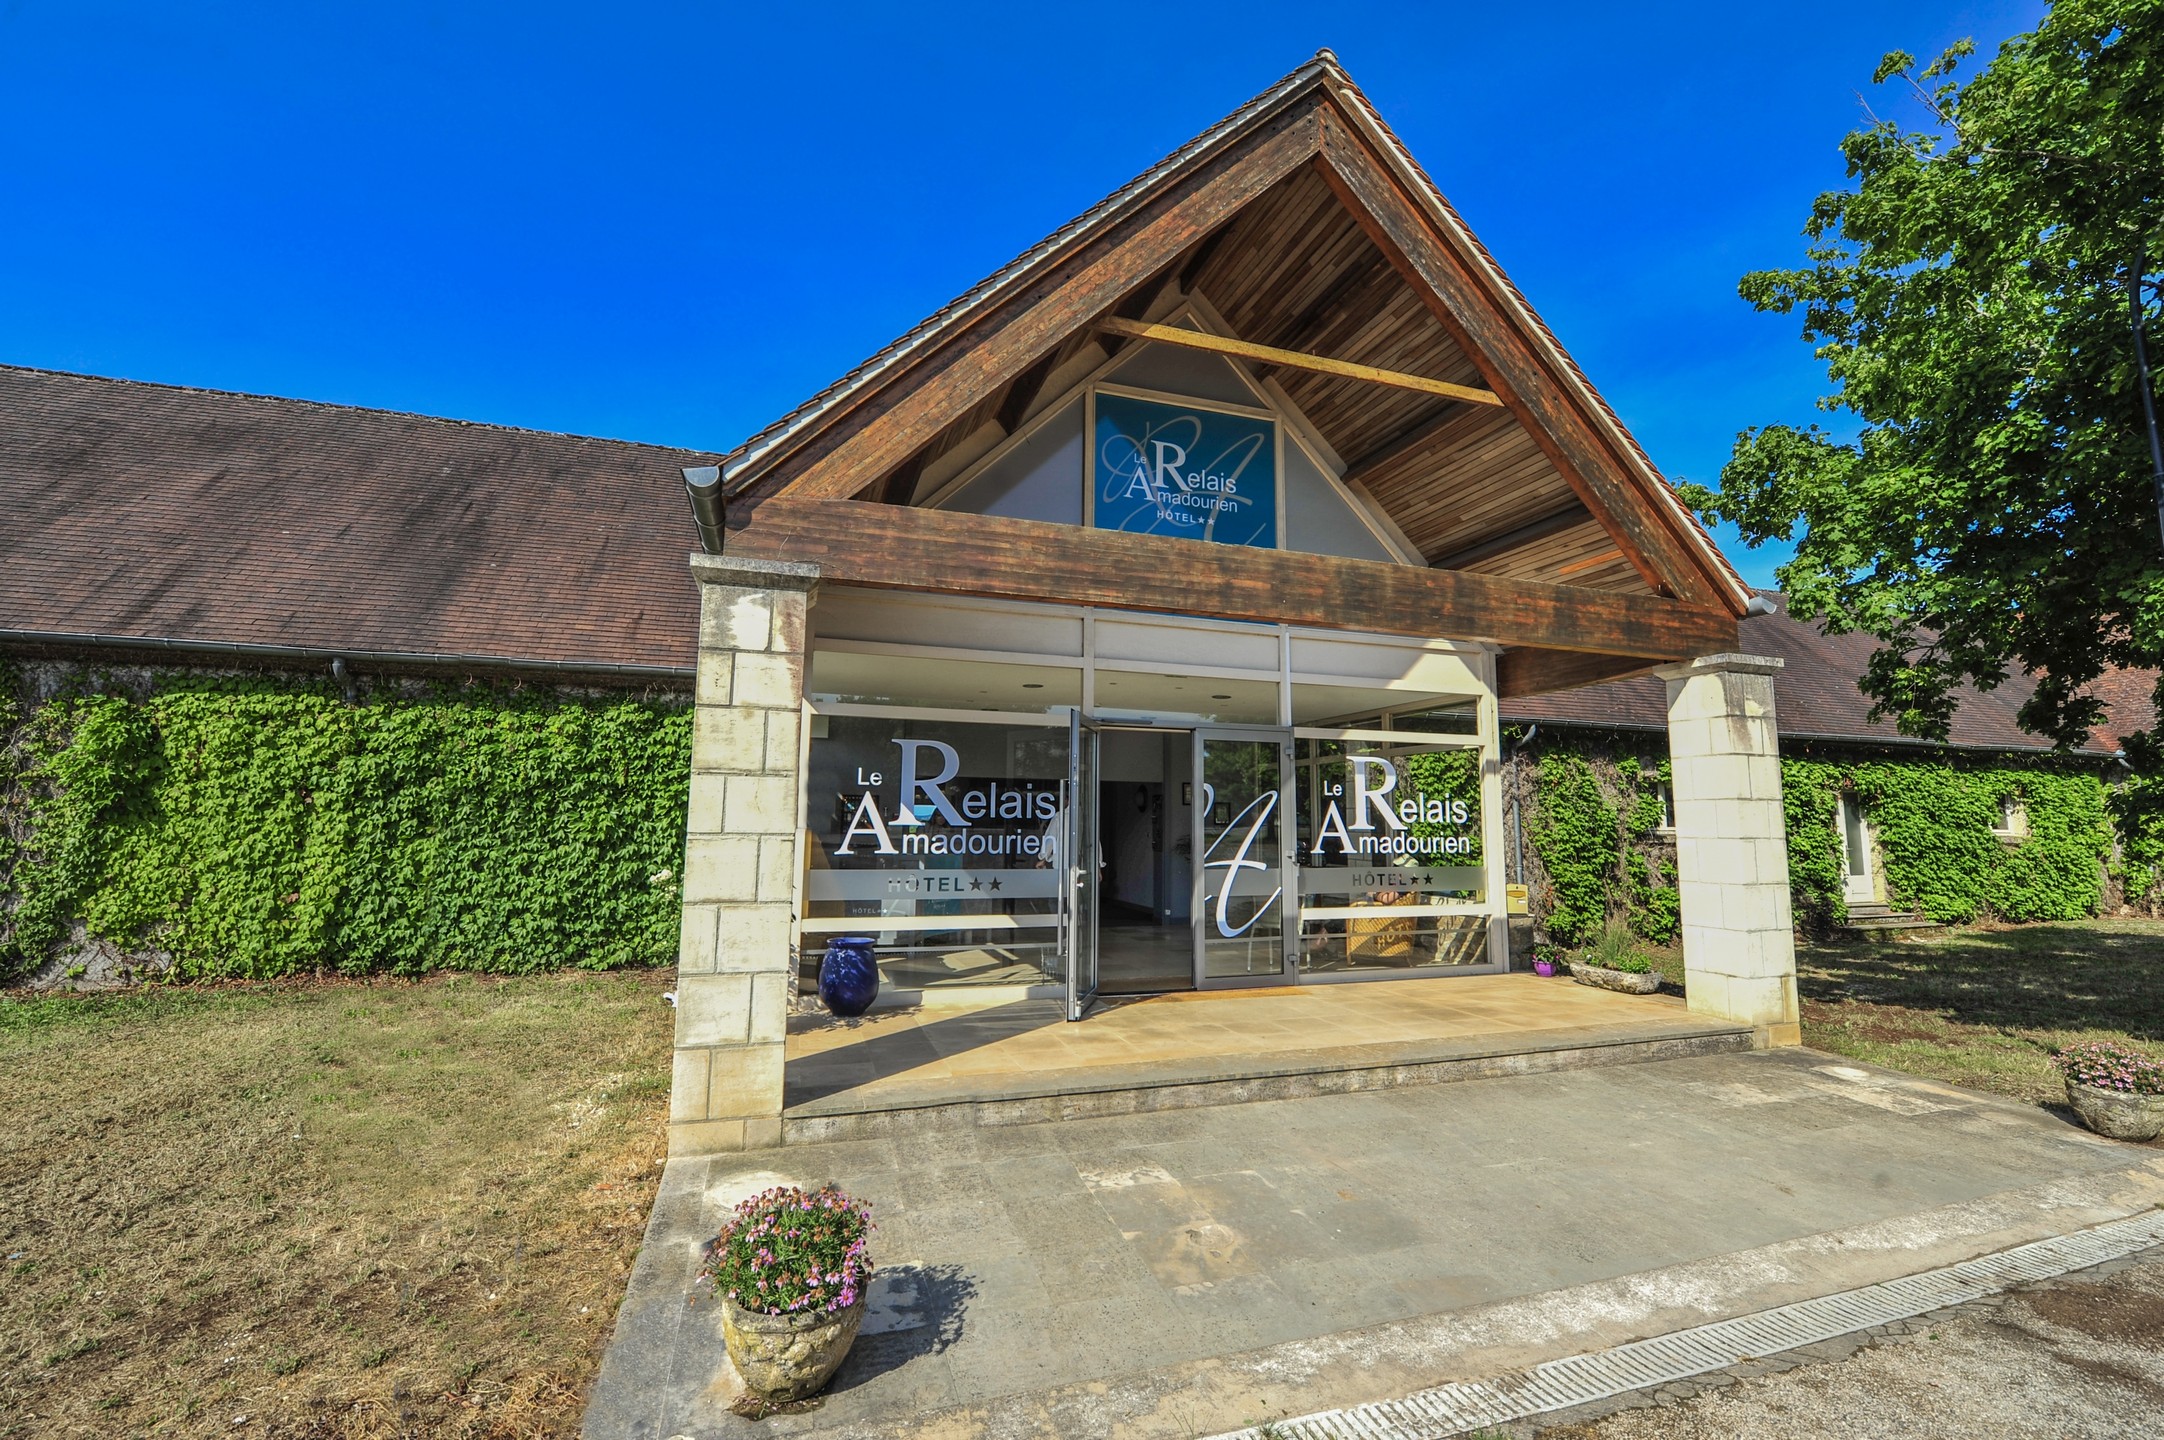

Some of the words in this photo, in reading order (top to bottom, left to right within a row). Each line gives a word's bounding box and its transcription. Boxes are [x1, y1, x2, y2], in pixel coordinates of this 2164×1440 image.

[1134, 453, 1147, 464] Le
[1150, 439, 1237, 493] Relais
[1123, 466, 1238, 513] Amadourien
[1156, 509, 1196, 524] HÔTEL
[857, 767, 883, 786] Le
[888, 738, 1057, 827] Relais
[1323, 780, 1343, 797] Le
[1346, 755, 1469, 831] Relais
[833, 791, 1058, 855] Amadourien
[1310, 800, 1470, 854] Amadourien
[887, 874, 965, 892] HÔTEL
[1352, 870, 1408, 887] HÔTEL
